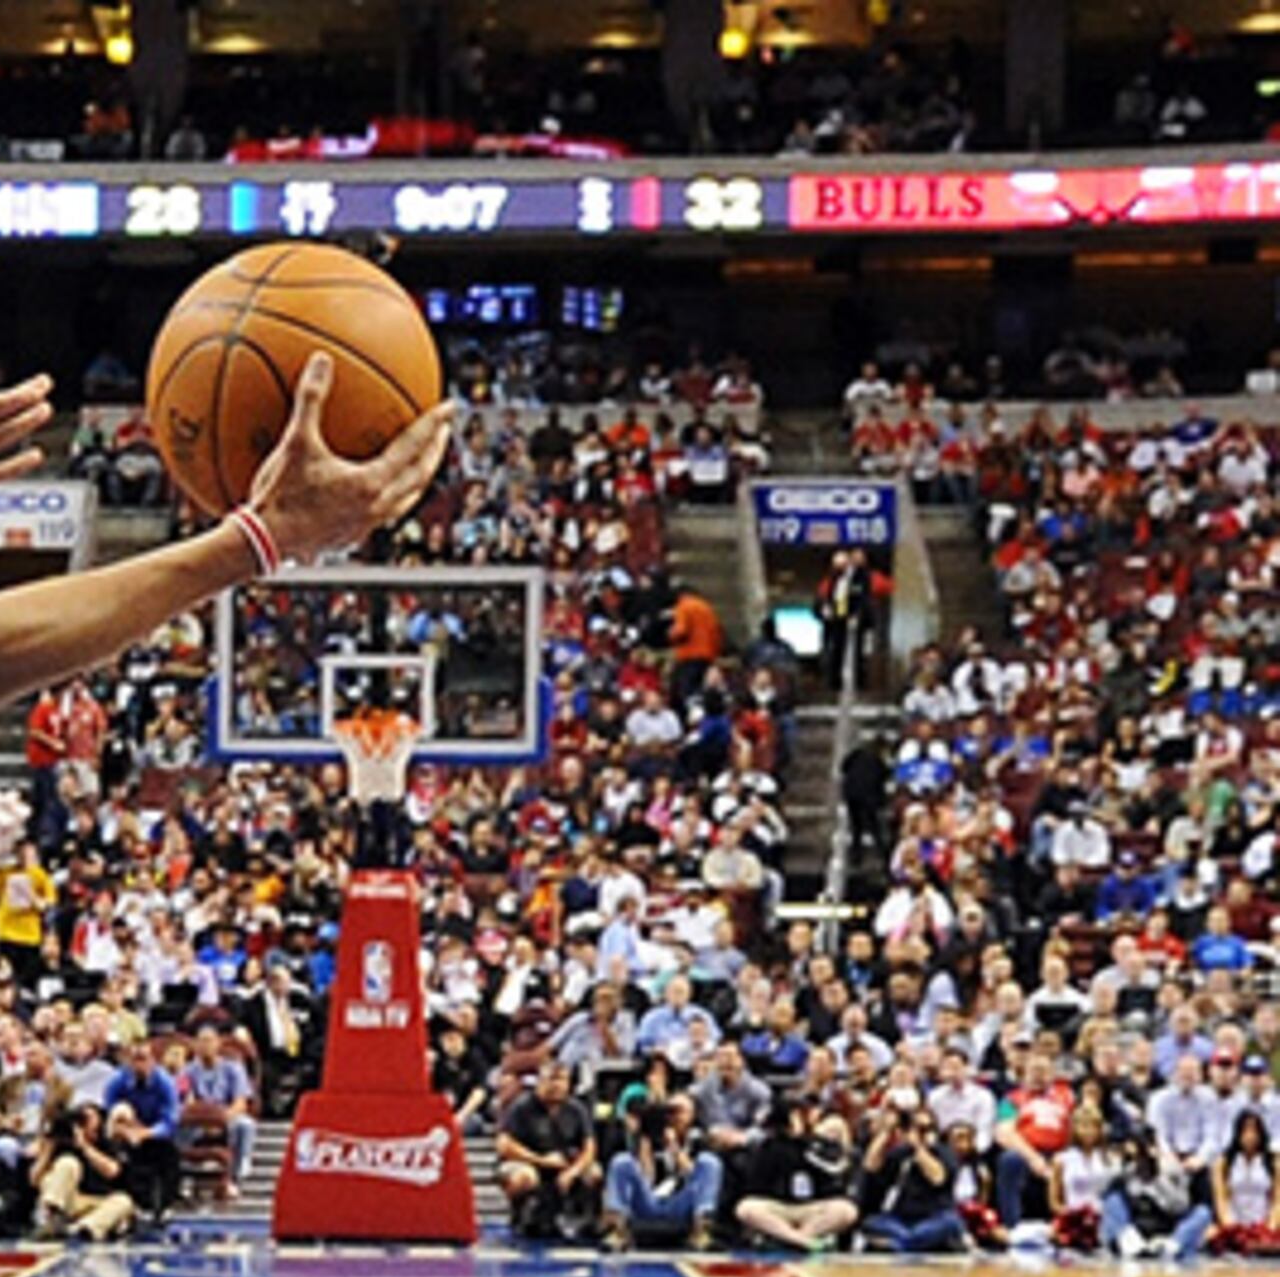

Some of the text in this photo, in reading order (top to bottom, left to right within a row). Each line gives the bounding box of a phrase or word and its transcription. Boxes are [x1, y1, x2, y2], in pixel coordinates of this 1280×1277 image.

[683, 176, 763, 229] 32
[815, 179, 985, 220] BULLS
[767, 487, 881, 513] GEICO
[315, 1138, 445, 1176] PLAYOFFS
